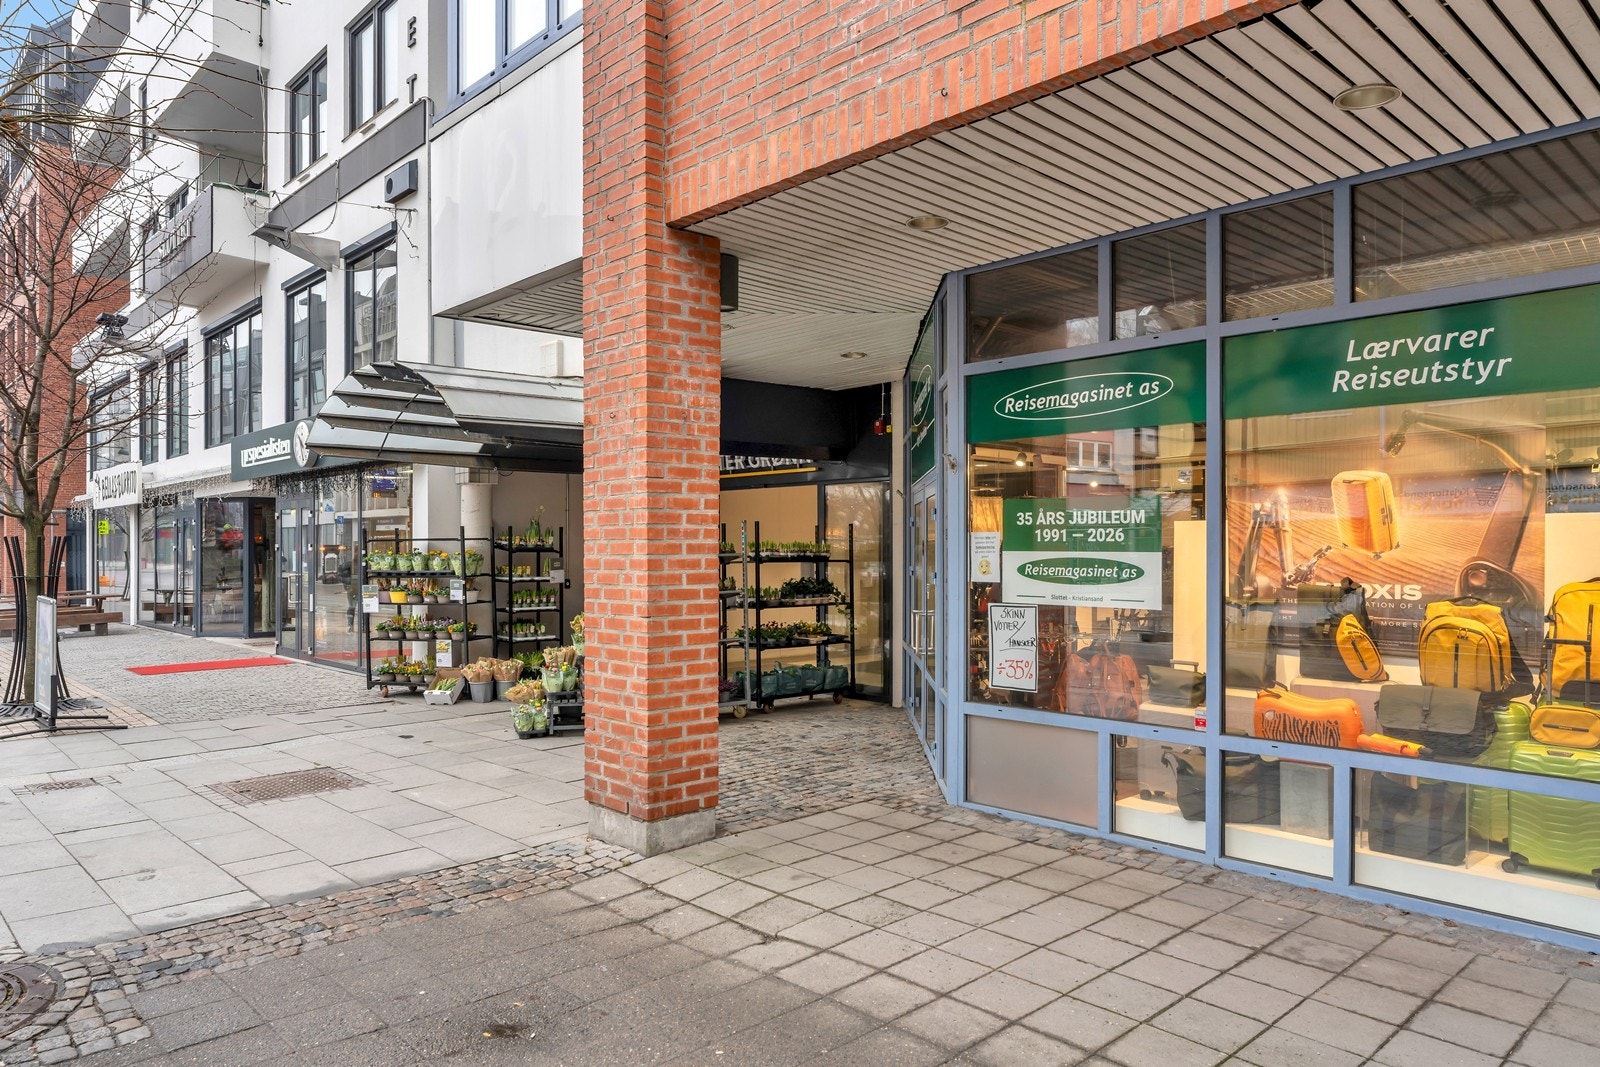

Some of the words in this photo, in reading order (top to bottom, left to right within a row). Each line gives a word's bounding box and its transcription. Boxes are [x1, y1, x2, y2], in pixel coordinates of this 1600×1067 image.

[1346, 327, 1495, 362] Lærvarer
[1332, 357, 1512, 393] Reiseutstyr
[1005, 382, 1133, 413] Reisemagasinet
[1139, 381, 1159, 396] as
[1017, 512, 1032, 525] 35
[1036, 508, 1065, 525] ÅRS
[1069, 510, 1145, 525] JUBILEUM
[1035, 529, 1067, 542] 1991
[1087, 528, 1125, 542] 2026
[1025, 564, 1118, 579] Reisemagasinet
[1122, 570, 1137, 578] as
[1001, 608, 1025, 619] SKINN
